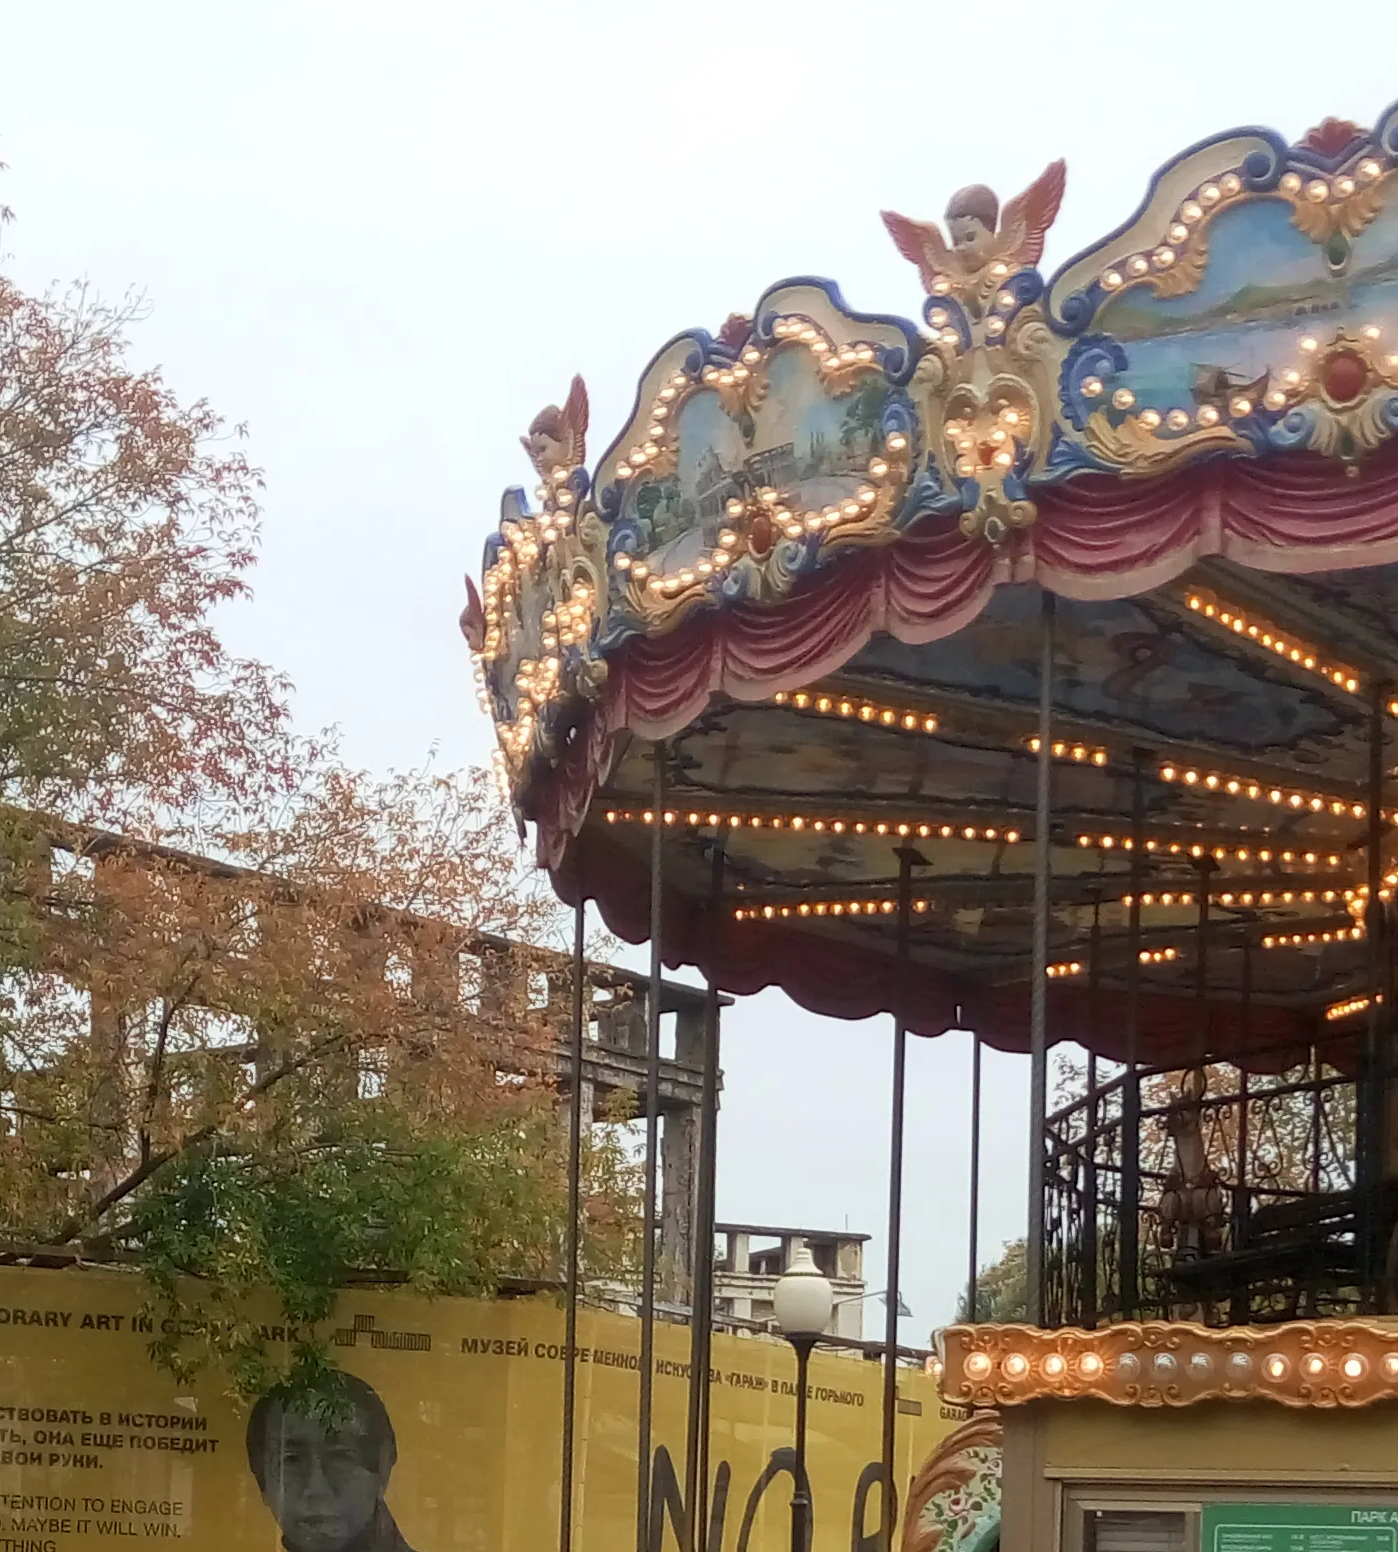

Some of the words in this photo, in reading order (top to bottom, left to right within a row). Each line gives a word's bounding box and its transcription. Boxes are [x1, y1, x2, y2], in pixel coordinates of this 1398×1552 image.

[80, 1313, 125, 1332] ART
[132, 1316, 153, 1333] IN
[256, 1325, 302, 1343] ARK
[461, 1337, 529, 1358] МУЗЕЙ
[771, 1380, 780, 1394] В
[99, 1412, 112, 1426] В
[118, 1413, 208, 1432] ИСТОРИИ
[33, 1429, 74, 1447] ОНА
[81, 1432, 124, 1450] ЕЩЕ
[129, 1435, 220, 1455] ПОБЕДИТ
[82, 1497, 105, 1514] TO
[110, 1498, 184, 1517] ENGAGE
[1351, 1510, 1387, 1524] ПАРК
[11, 1517, 72, 1534] MAYBE
[77, 1519, 90, 1534] IT
[95, 1520, 139, 1537] WILL
[144, 1521, 182, 1539] WIN.
